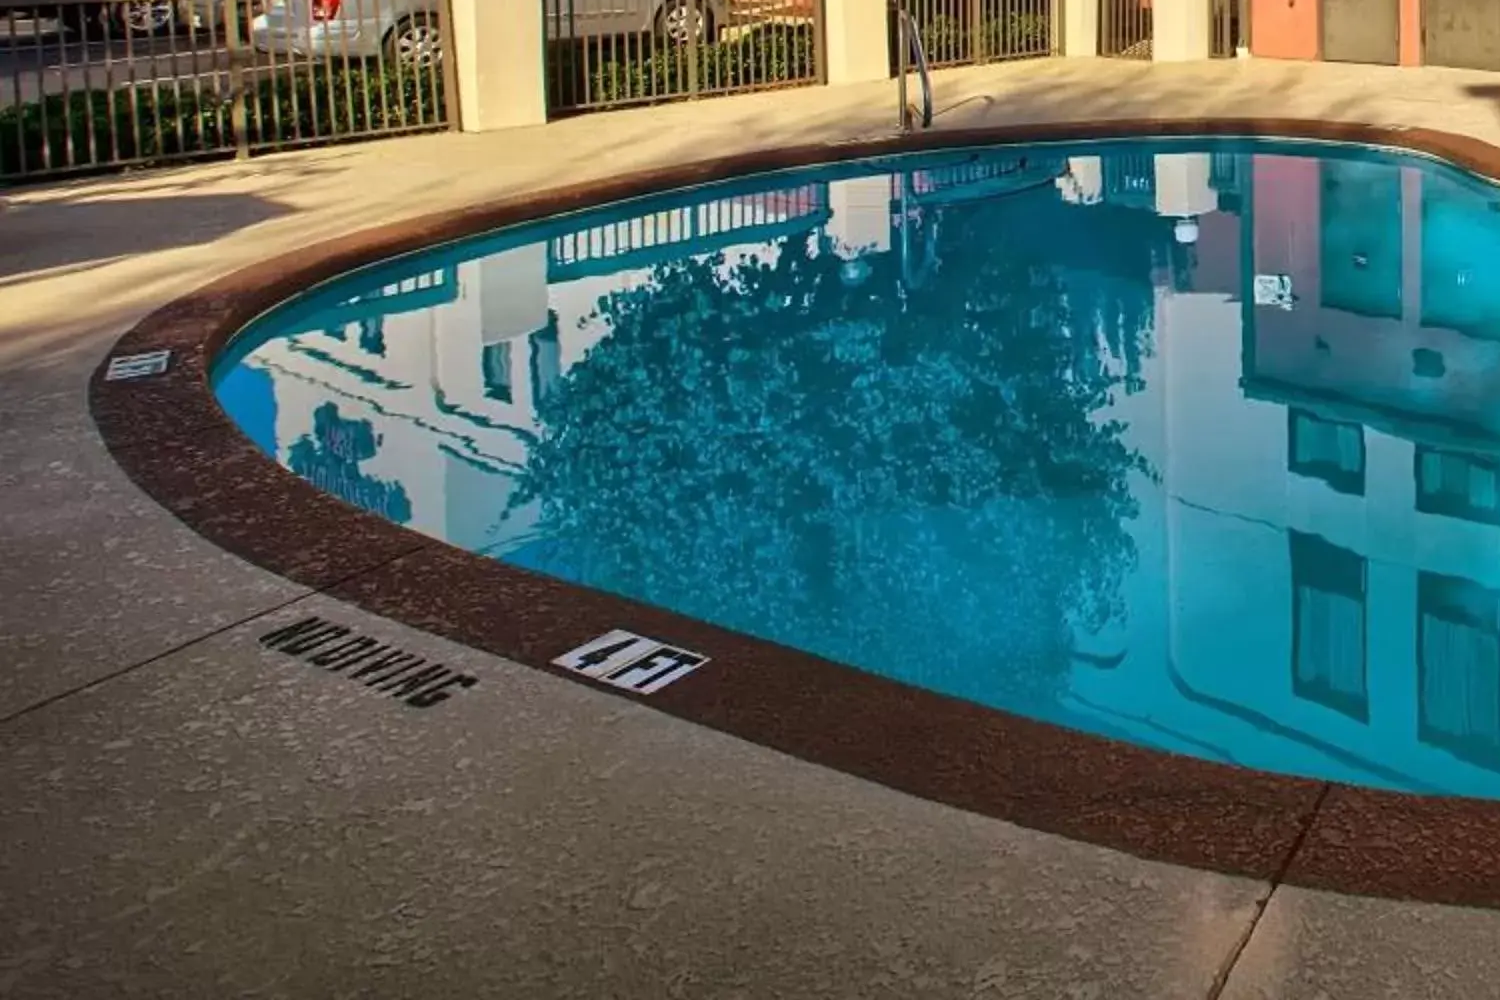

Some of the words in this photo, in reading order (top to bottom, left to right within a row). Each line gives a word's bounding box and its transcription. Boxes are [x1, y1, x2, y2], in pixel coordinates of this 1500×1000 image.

[259, 616, 350, 656] NO
[306, 636, 479, 709] DIVING
[574, 637, 641, 670] 4
[607, 647, 704, 689] FT
